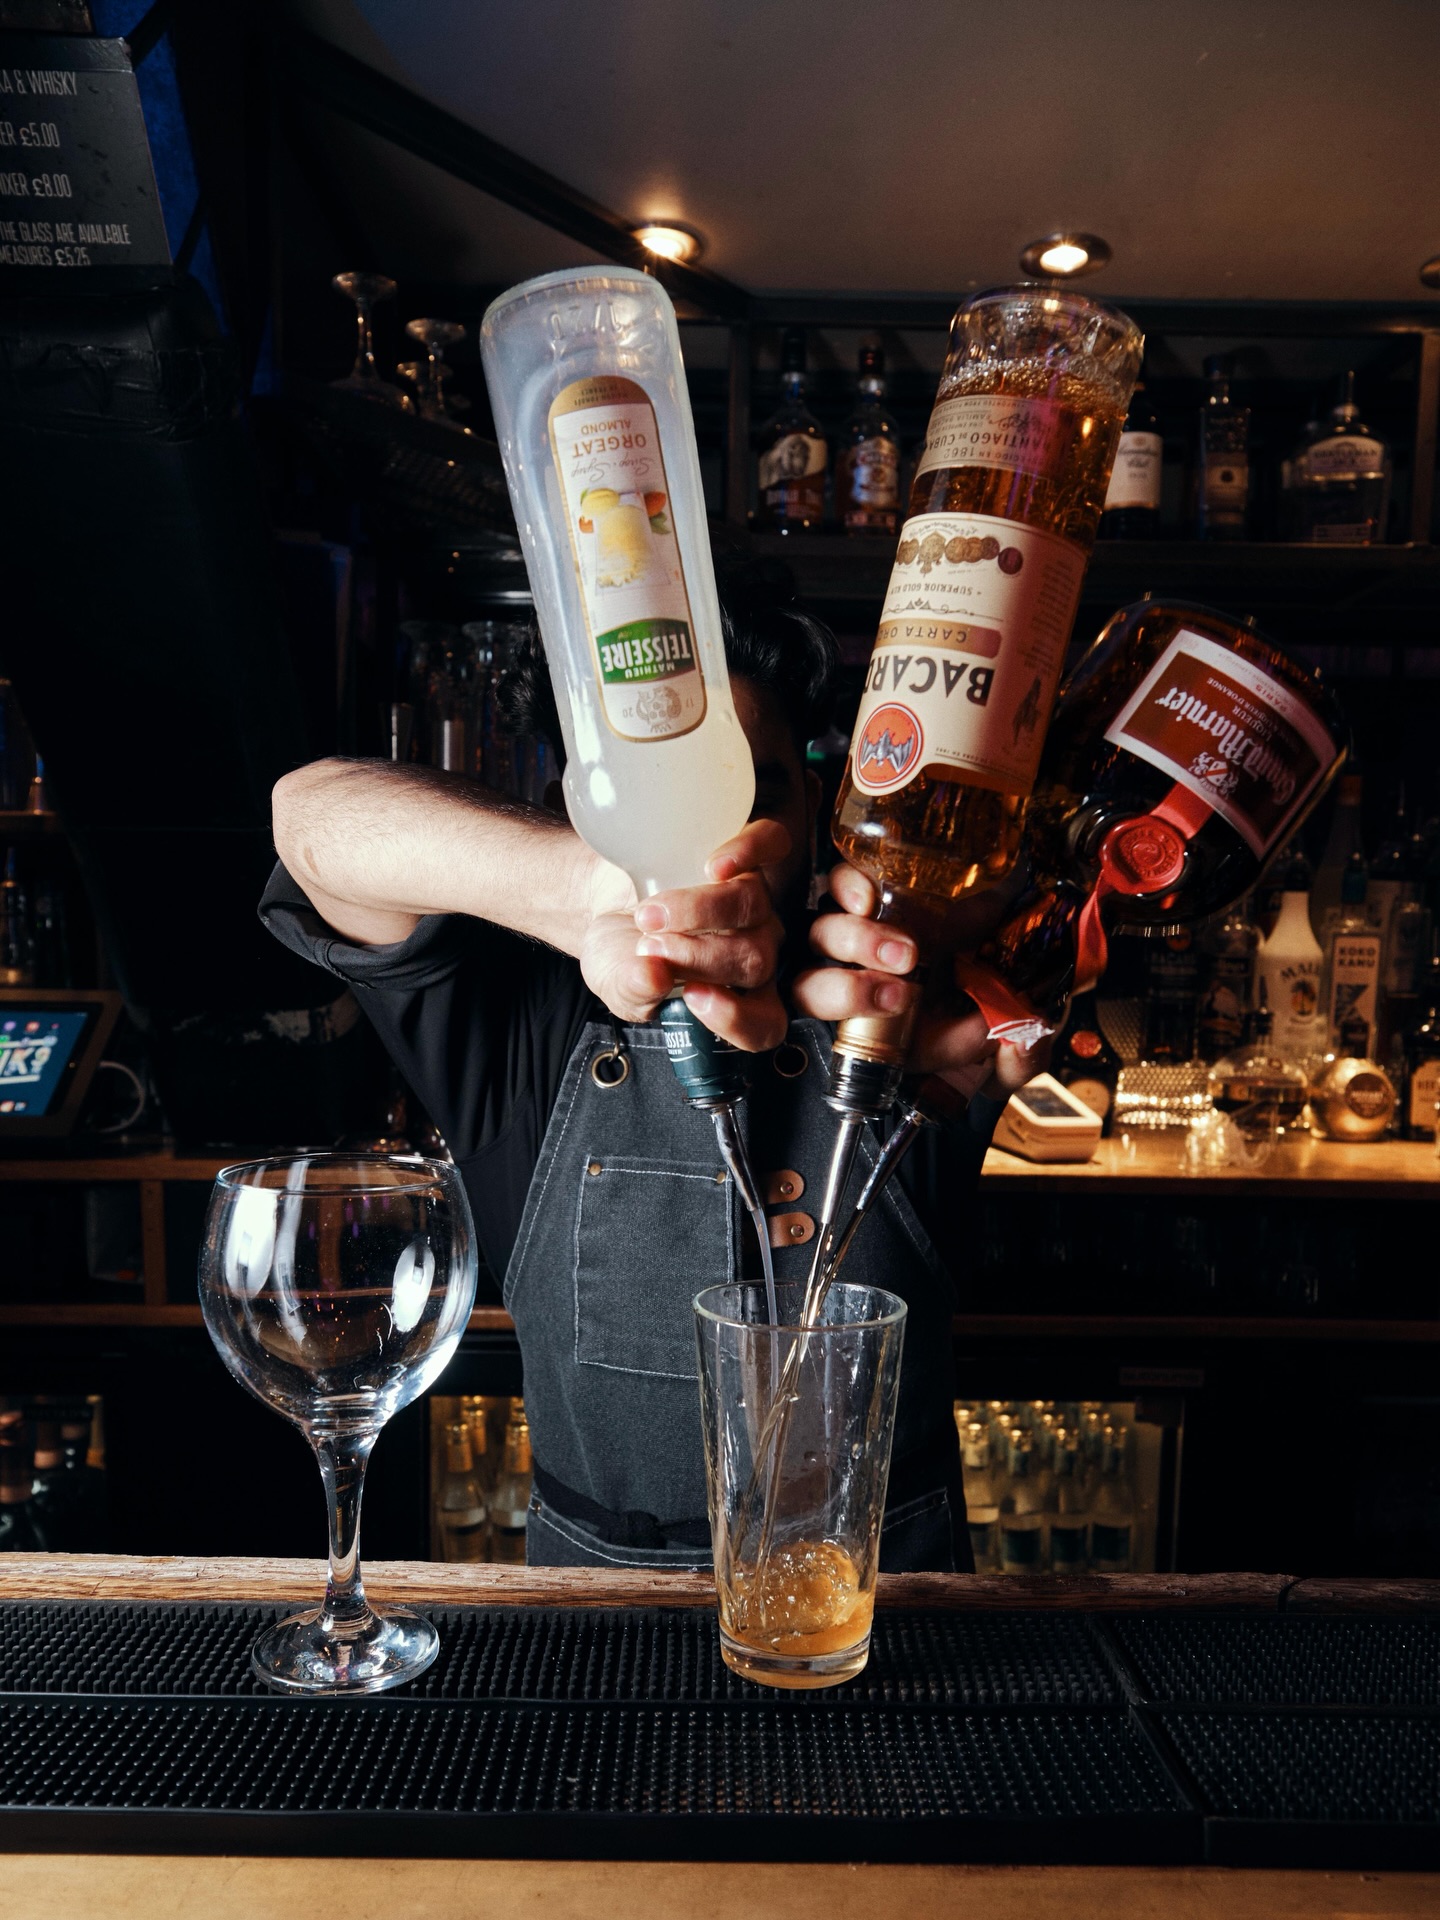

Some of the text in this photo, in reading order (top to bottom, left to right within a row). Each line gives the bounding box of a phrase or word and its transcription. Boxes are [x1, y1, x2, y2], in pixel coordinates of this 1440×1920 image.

[0, 69, 78, 96] A & WHISKY
[19, 122, 61, 148] £5.00
[31, 173, 73, 198] £8.00
[18, 221, 54, 243] GLASS
[55, 222, 78, 243] ARE
[78, 223, 132, 245] AVAILABLE
[54, 246, 92, 267] £5.25
[580, 418, 631, 436] ALMOND
[571, 433, 647, 459] ORGEAT
[927, 434, 956, 452] CUBA
[943, 446, 976, 459] 1862
[902, 583, 922, 593] GOLD
[924, 583, 974, 596] SUPERIOR
[905, 626, 968, 644] CARTA
[601, 634, 690, 673] TEISSEIRE
[624, 661, 675, 679] MATHIEU
[1206, 677, 1245, 706] D'ORANGE
[1256, 684, 1287, 711] PARIS
[621, 706, 635, 719] 20
[1154, 686, 1257, 766] Marnier
[1232, 705, 1273, 743] LIQUEUR
[1340, 947, 1376, 956] KOKO
[1338, 959, 1376, 967] KANU
